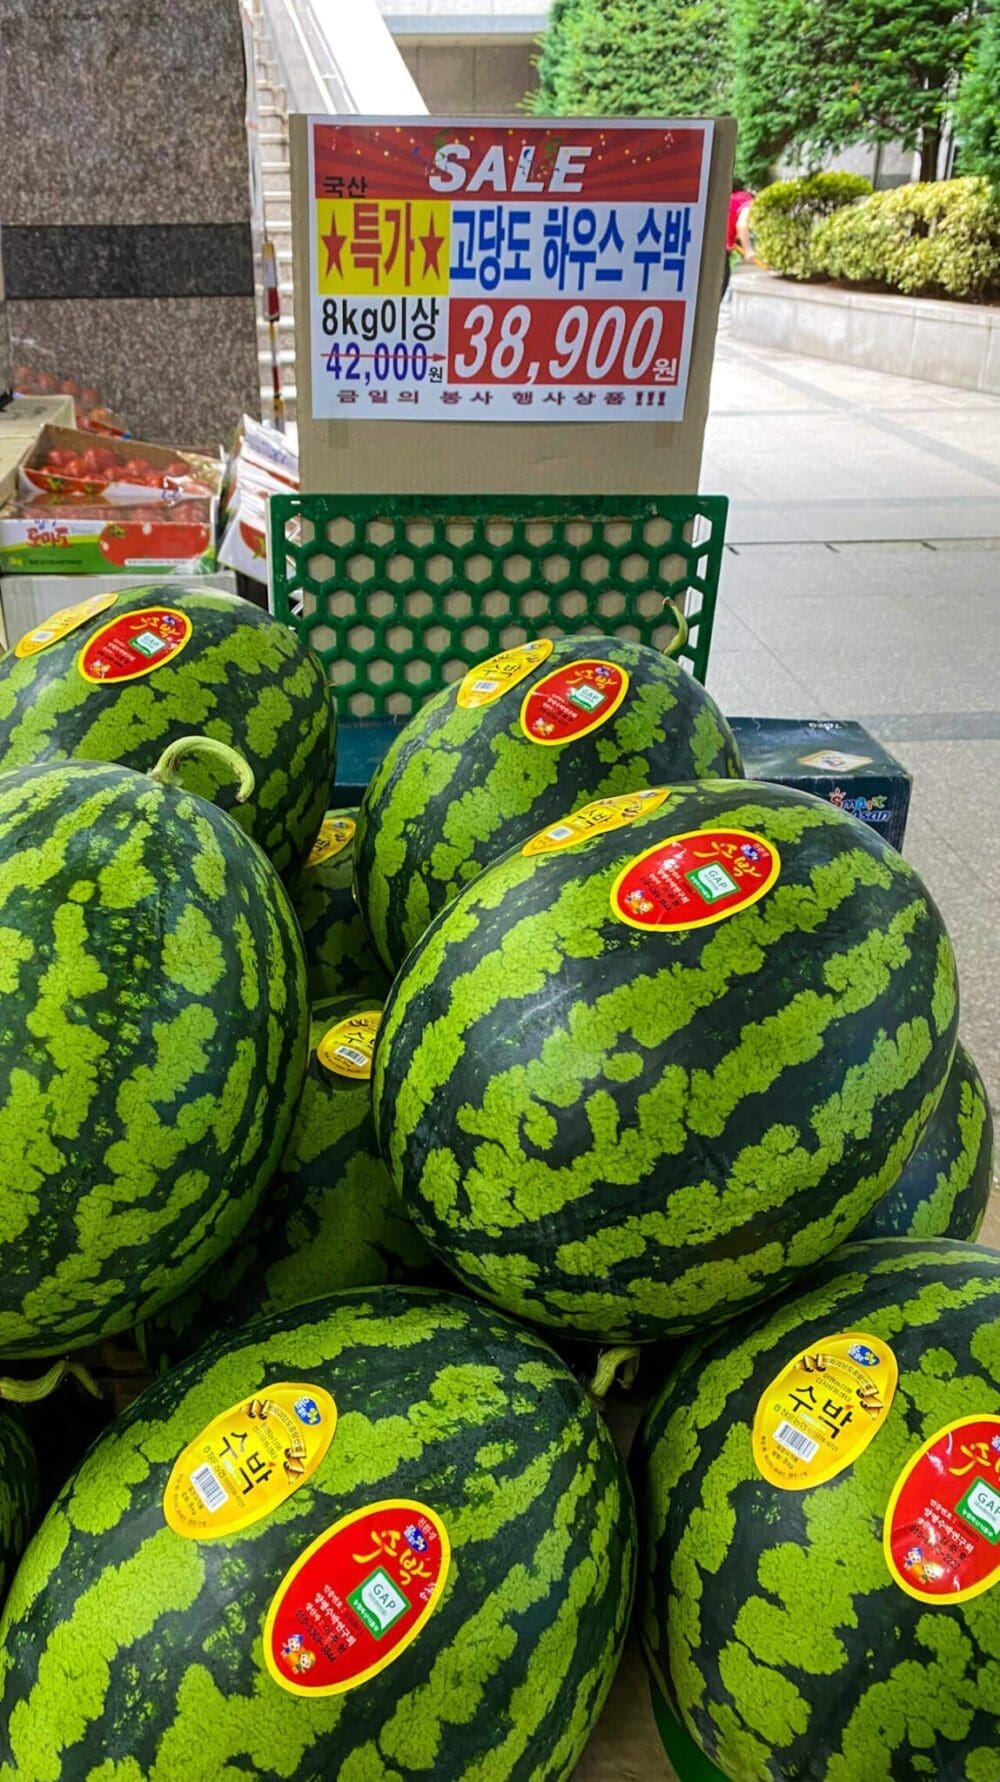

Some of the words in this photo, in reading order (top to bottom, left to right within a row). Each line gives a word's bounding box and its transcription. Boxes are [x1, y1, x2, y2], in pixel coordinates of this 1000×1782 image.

[322, 176, 368, 198] 국산
[429, 144, 592, 193] SALE
[350, 202, 415, 287] 특가
[449, 205, 531, 291] 고당도
[543, 206, 623, 291] 하우스
[633, 207, 691, 292] 수박
[322, 297, 440, 342] 8kg이상
[337, 389, 420, 405] 금일의
[440, 390, 493, 406] 봉사
[483, 663, 522, 678] 수박
[572, 808, 615, 829] 수박
[693, 841, 762, 878] 수박
[708, 870, 728, 889] GAP
[789, 1385, 853, 1439] 수박
[219, 1432, 272, 1495] 수박
[352, 1530, 432, 1586] 수박
[373, 1583, 397, 1610] GAP
